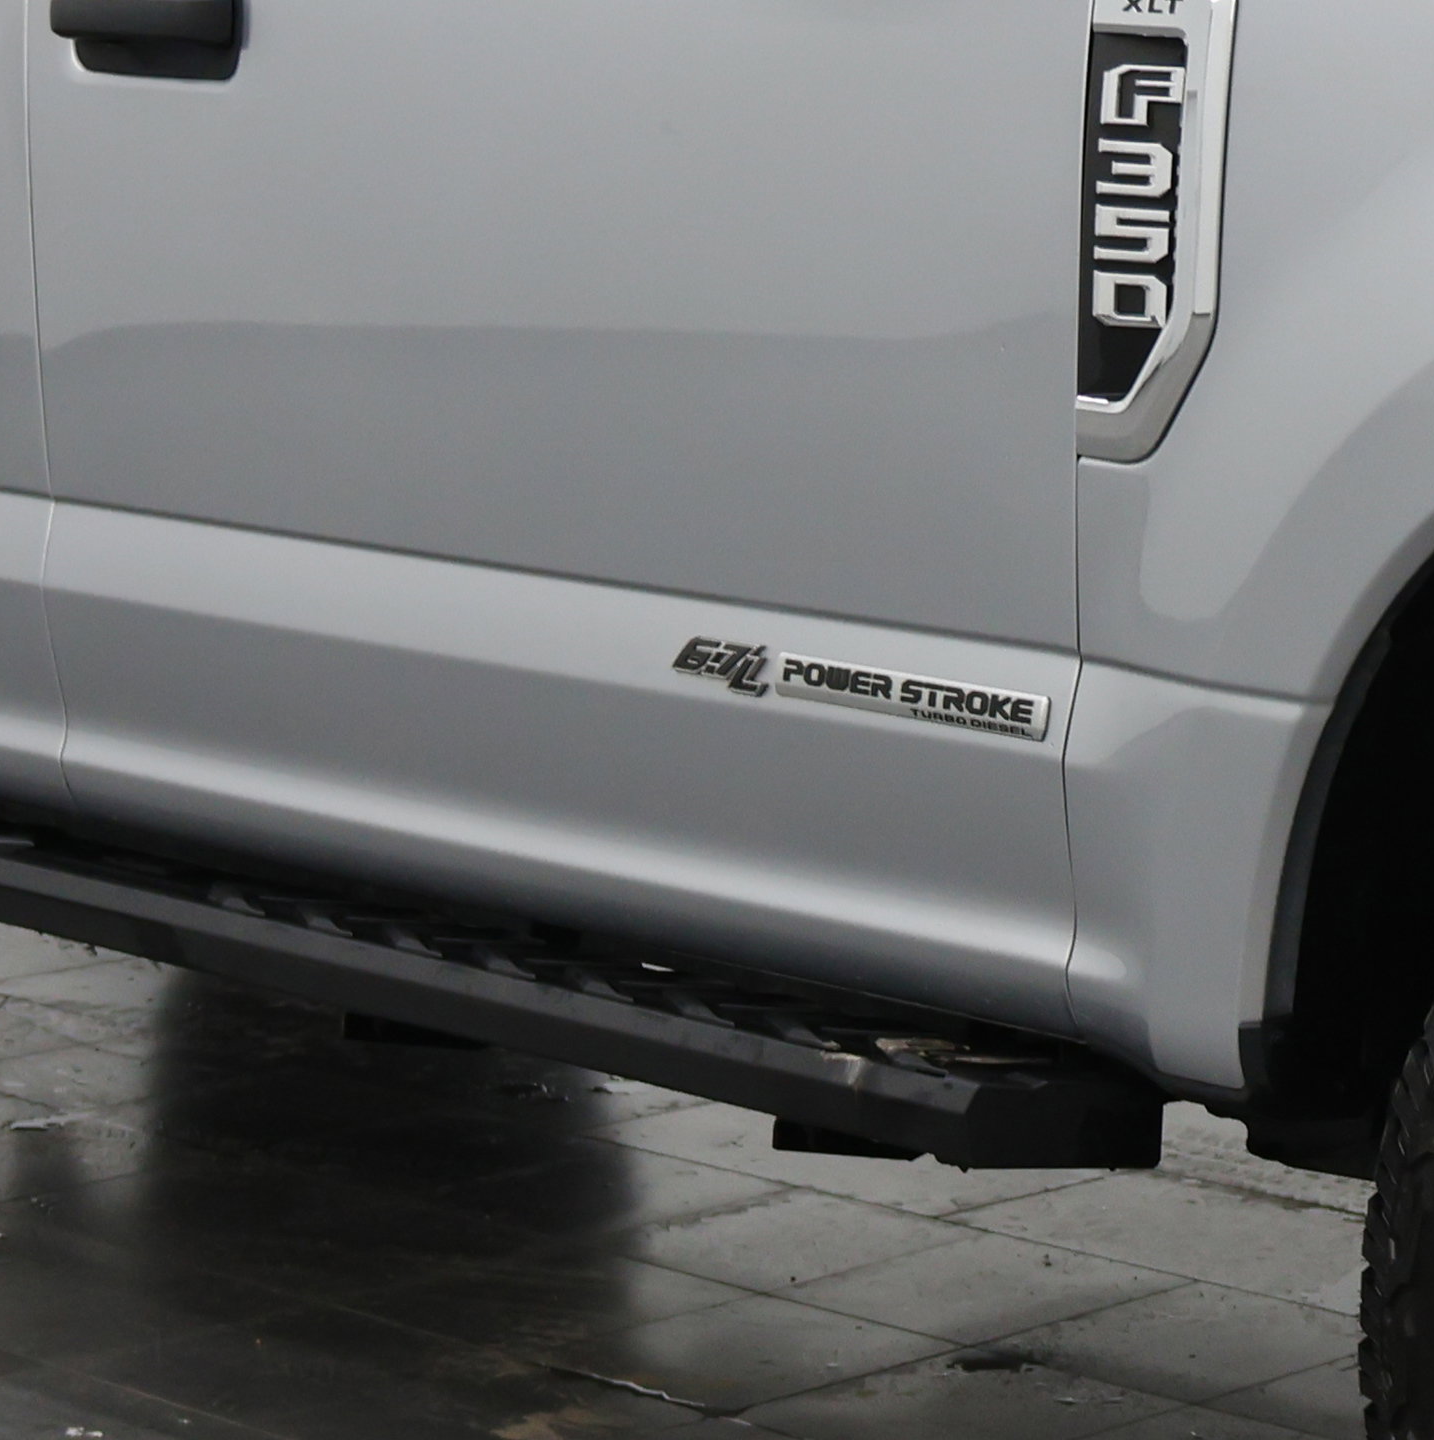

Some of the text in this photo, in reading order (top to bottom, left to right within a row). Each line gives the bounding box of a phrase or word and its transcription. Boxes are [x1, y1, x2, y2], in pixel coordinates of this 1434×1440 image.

[673, 636, 1033, 724] 6.7L POWER STROKE
[911, 708, 1033, 736] TURBO DIESEL
